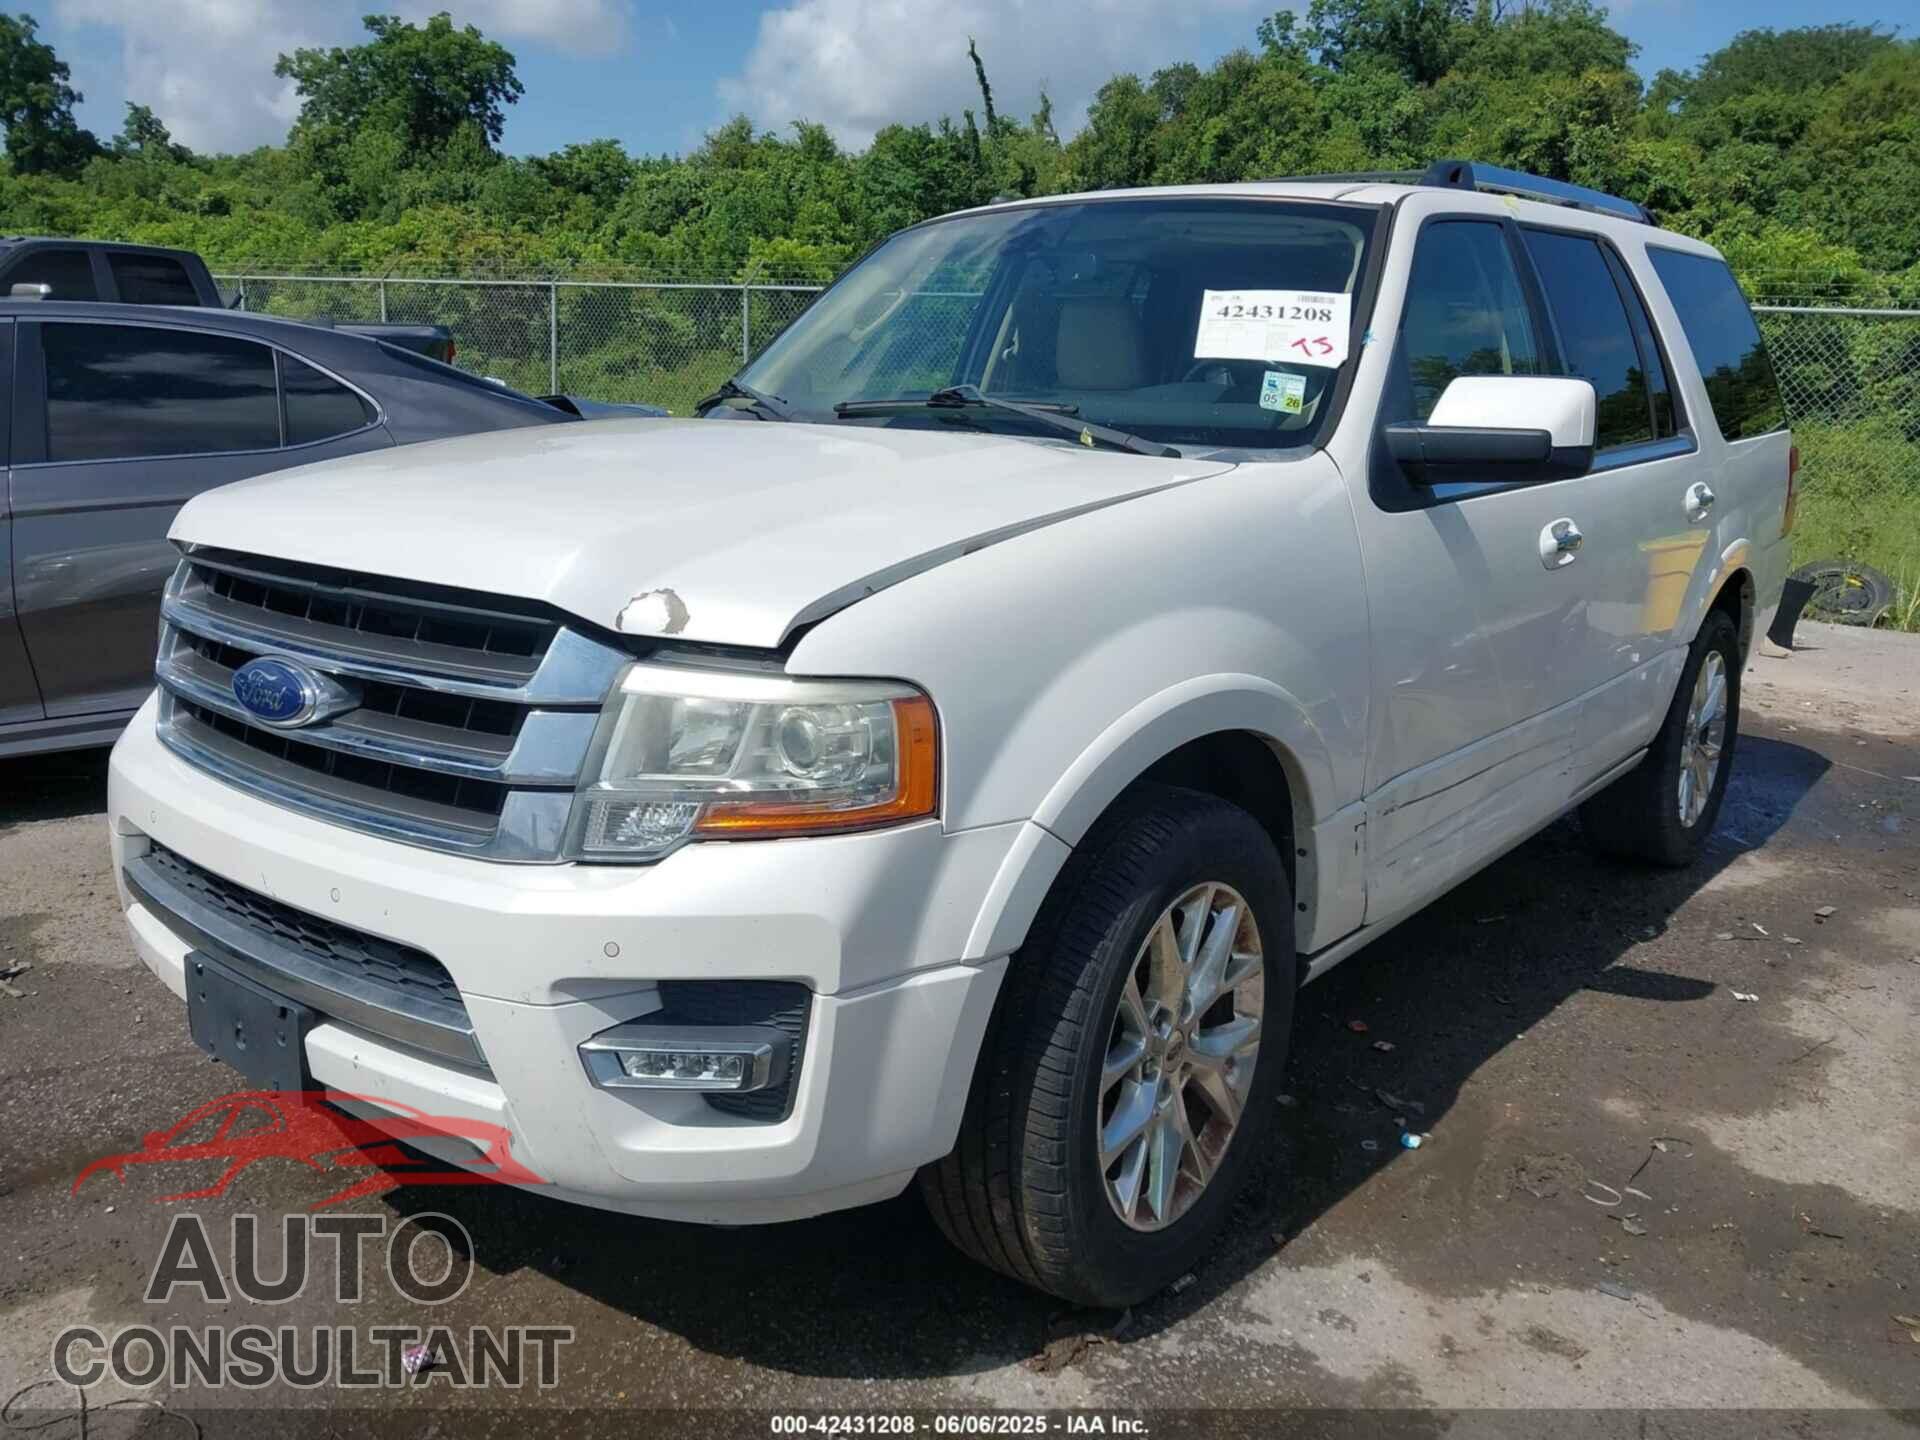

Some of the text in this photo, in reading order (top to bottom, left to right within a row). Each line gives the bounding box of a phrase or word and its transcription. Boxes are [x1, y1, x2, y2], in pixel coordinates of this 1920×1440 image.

[1216, 305, 1332, 322] 42431208
[1263, 393, 1300, 408] 05 26
[239, 668, 288, 711] Ford
